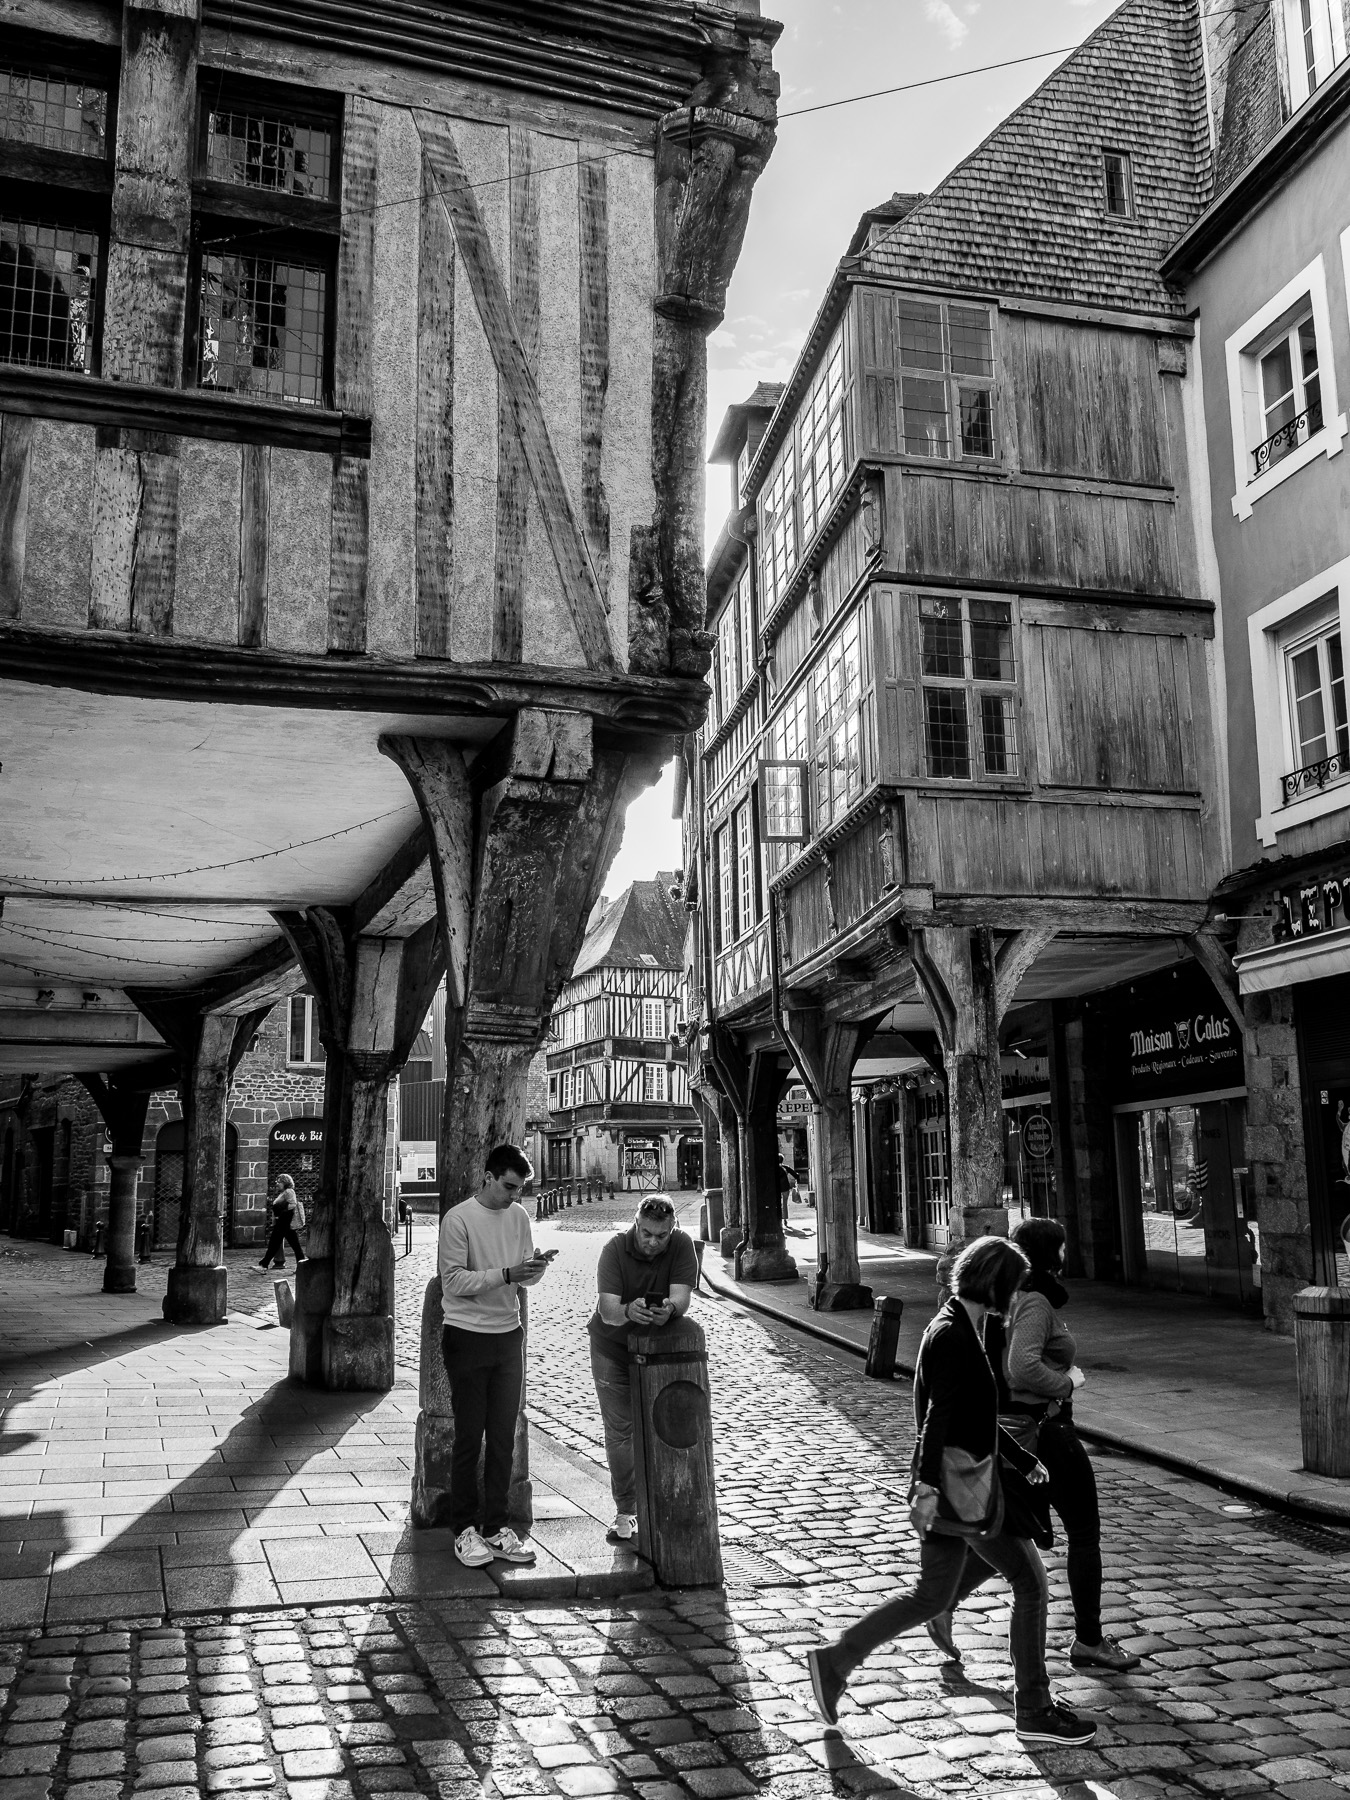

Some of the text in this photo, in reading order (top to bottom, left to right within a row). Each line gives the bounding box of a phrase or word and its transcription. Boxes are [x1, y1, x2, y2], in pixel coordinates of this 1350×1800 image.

[1130, 1029, 1173, 1057] Maison
[1194, 1014, 1230, 1043] Colas
[1131, 1063, 1151, 1076] Produits
[1209, 1047, 1237, 1064] Souvenirs
[274, 1130, 297, 1142] Cave
[299, 1132, 307, 1142] à
